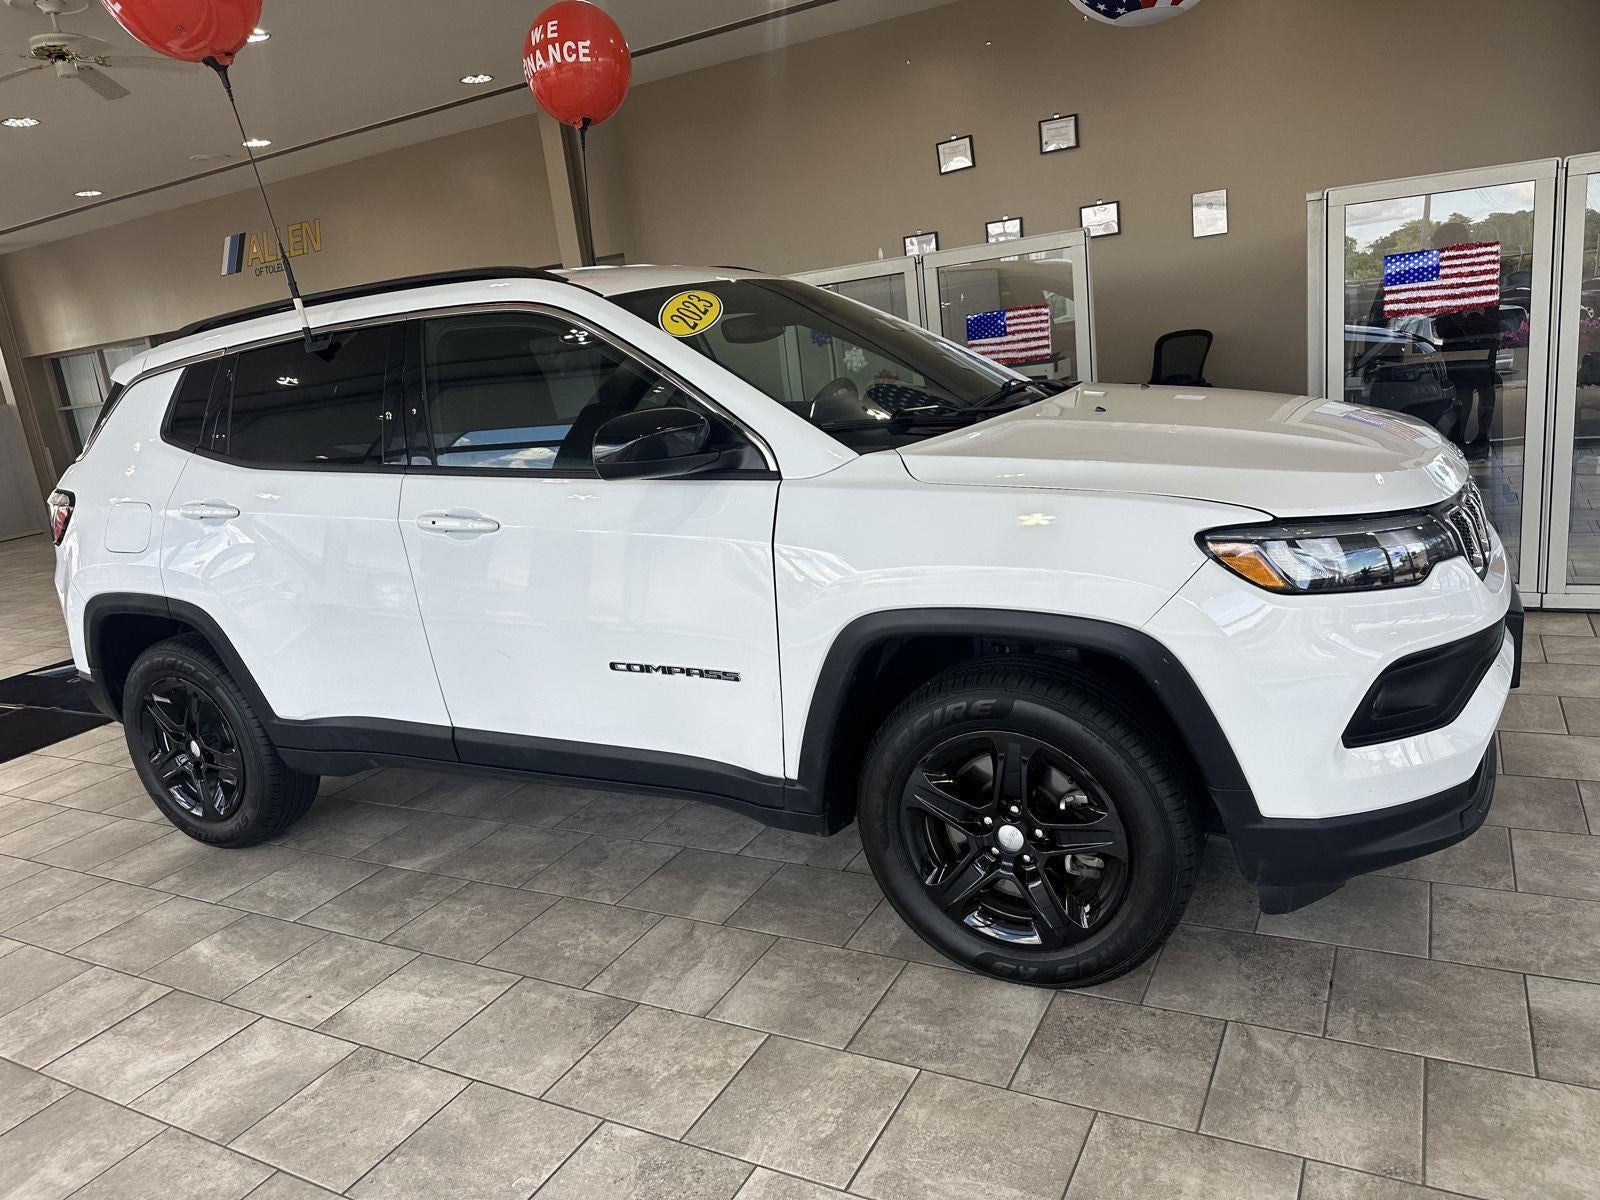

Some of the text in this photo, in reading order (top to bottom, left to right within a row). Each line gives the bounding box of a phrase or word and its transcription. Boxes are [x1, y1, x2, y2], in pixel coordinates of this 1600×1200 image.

[531, 20, 558, 46] WE
[670, 294, 713, 330] 2023
[609, 661, 742, 682] COMPASS
